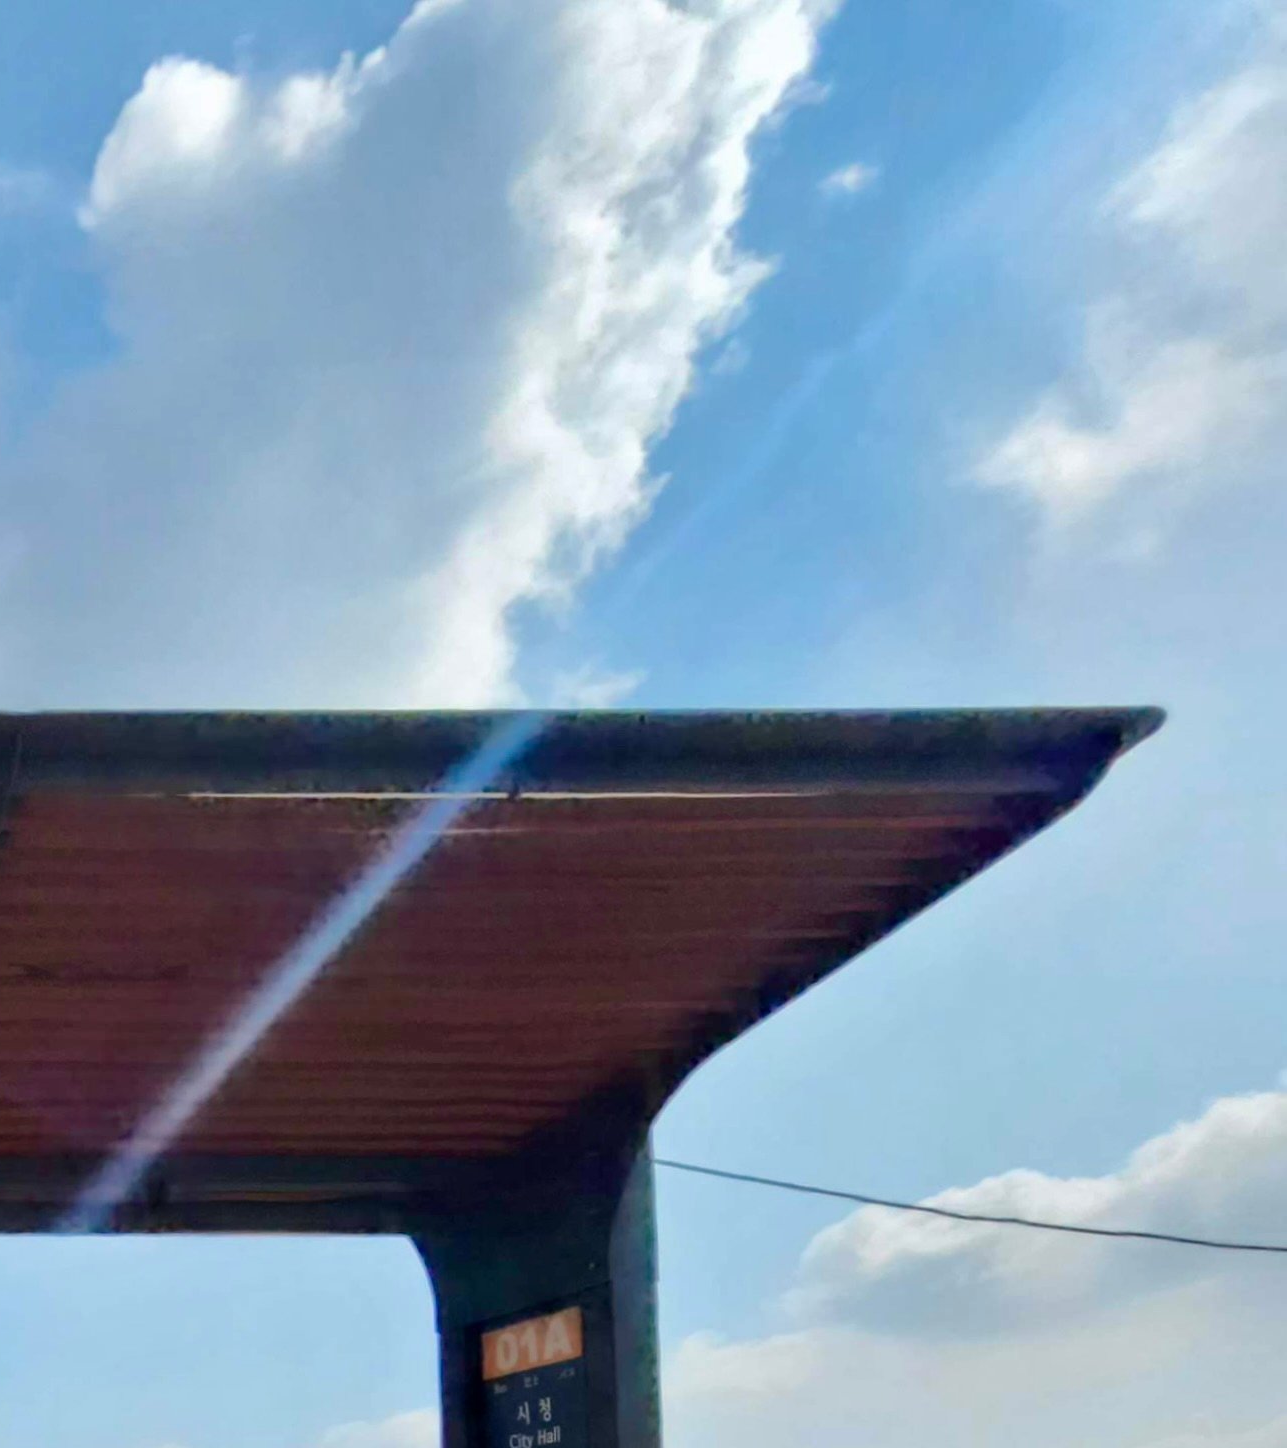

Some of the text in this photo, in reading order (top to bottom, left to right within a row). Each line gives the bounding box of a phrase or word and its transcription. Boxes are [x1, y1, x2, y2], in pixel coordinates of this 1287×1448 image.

[495, 1315, 573, 1372] 01A
[517, 1397, 552, 1424] 시청
[537, 1426, 561, 1445] Hall
